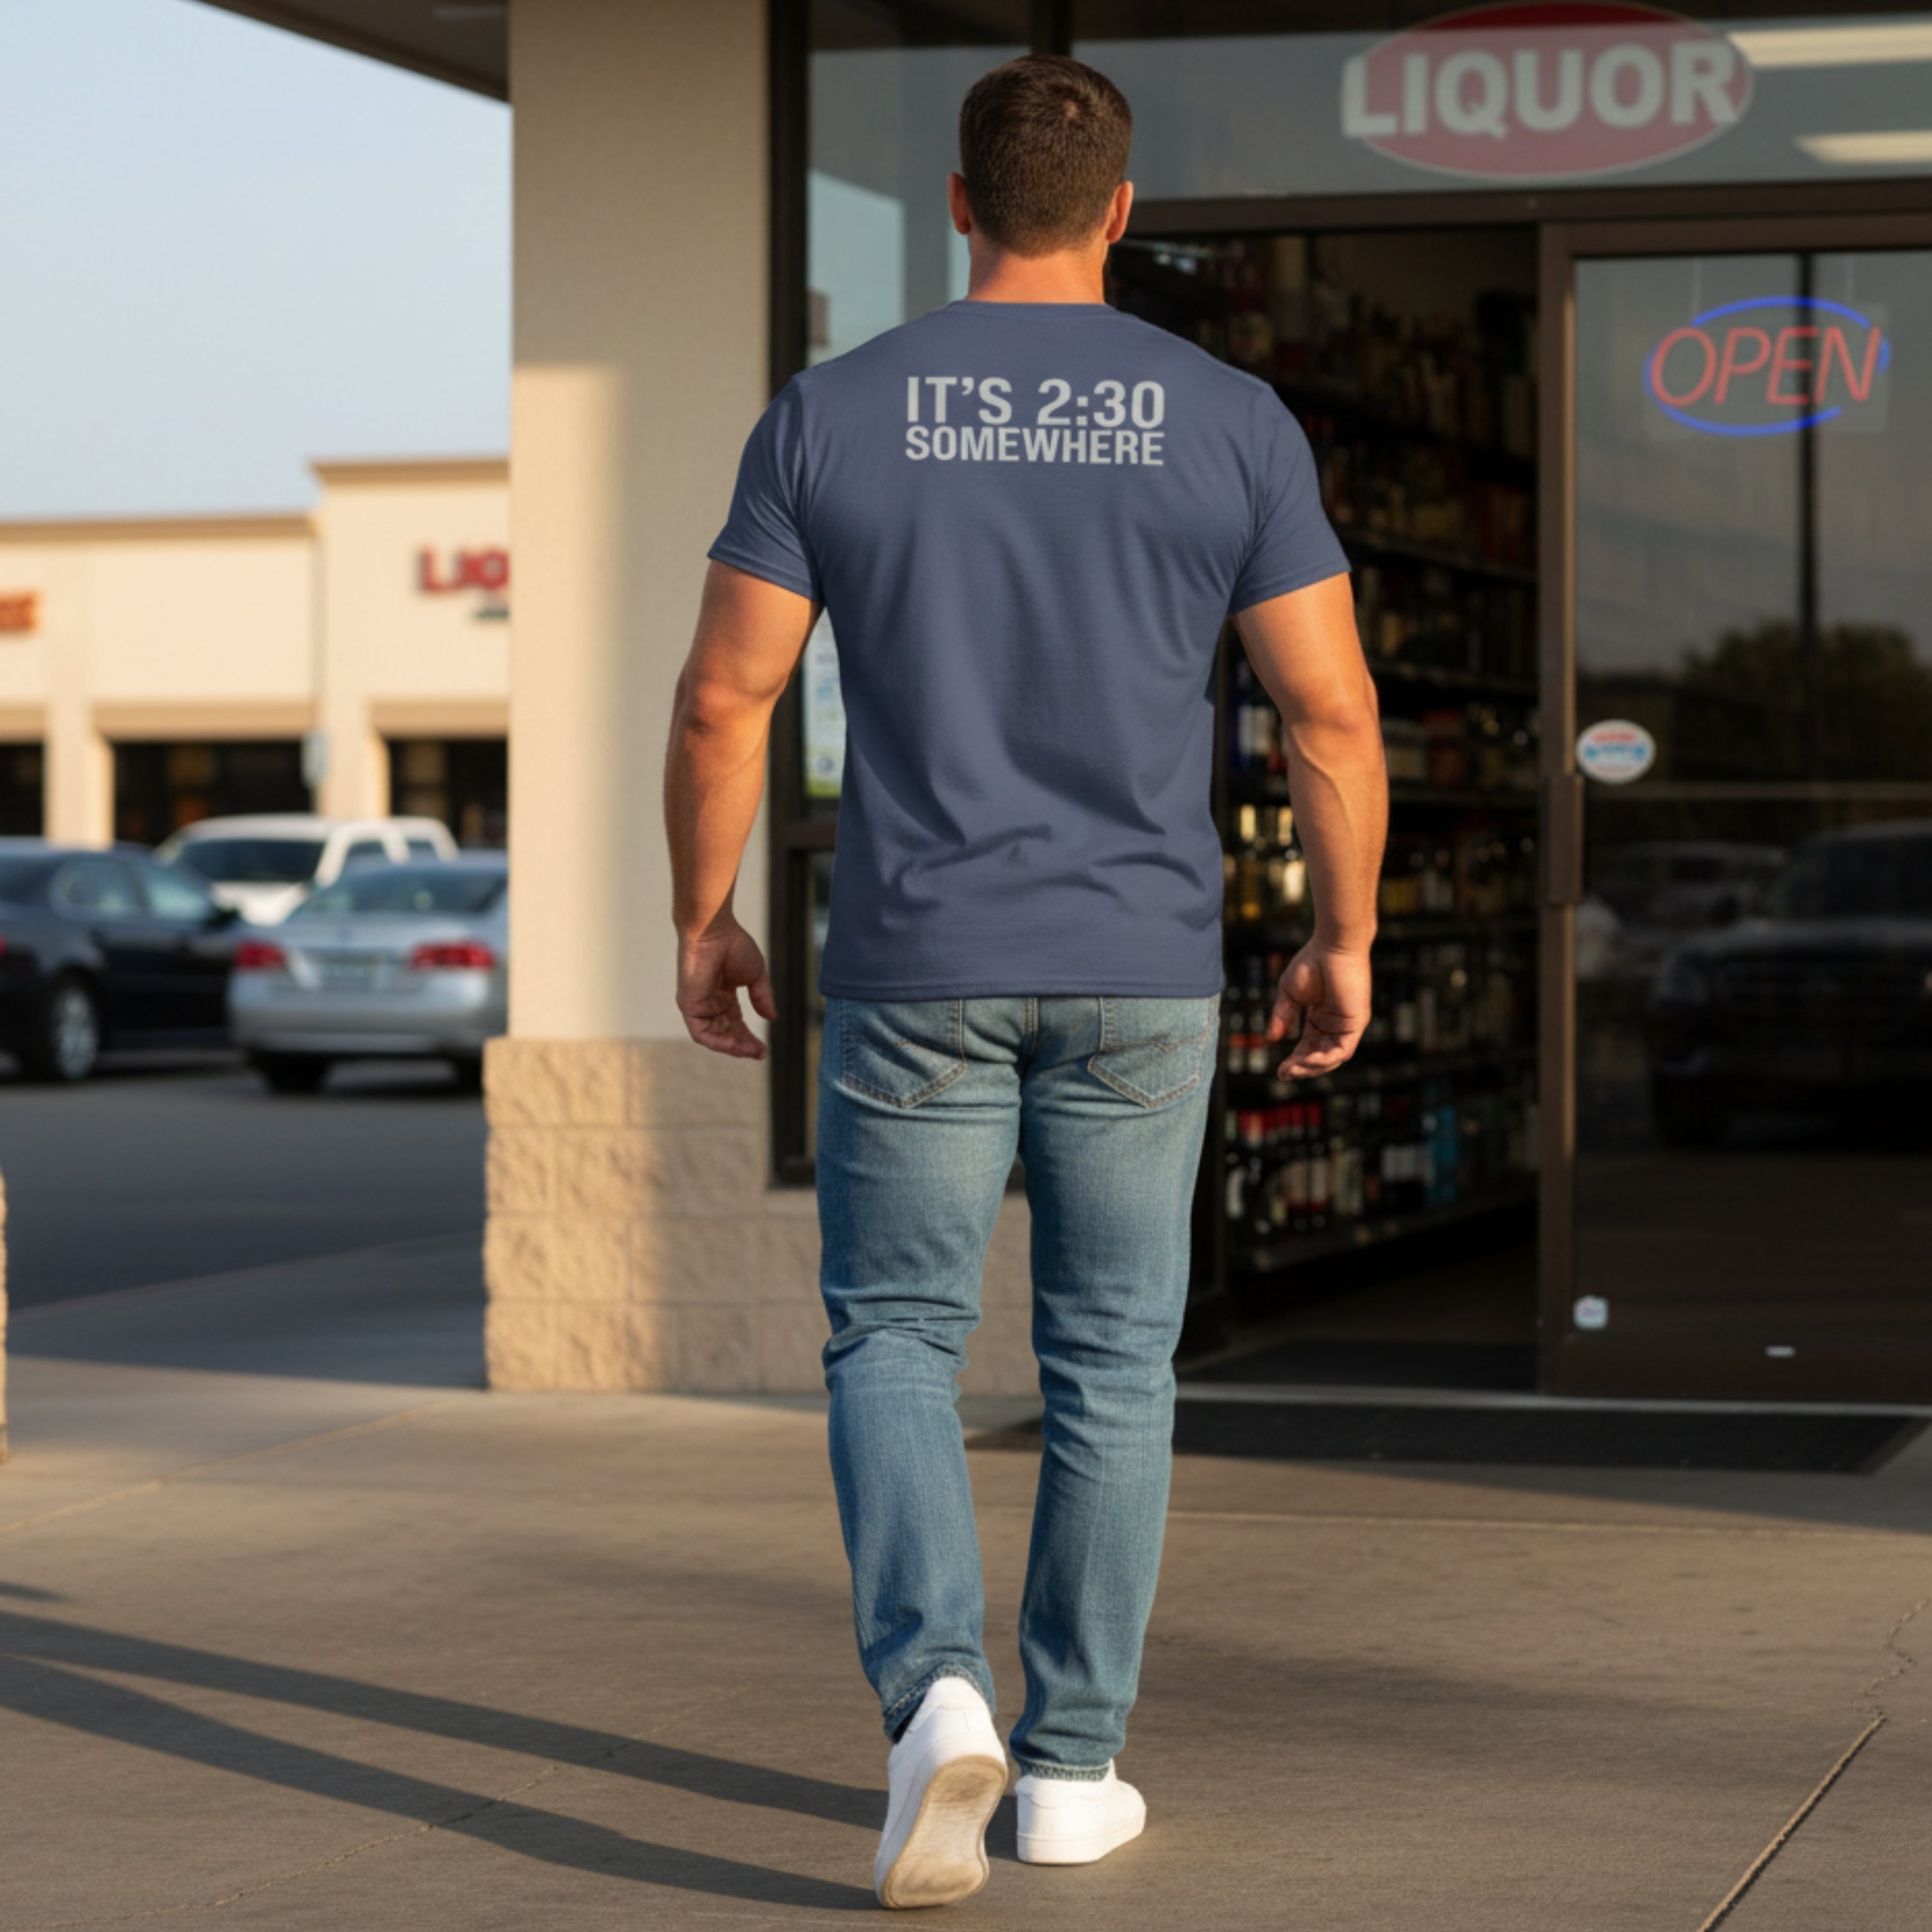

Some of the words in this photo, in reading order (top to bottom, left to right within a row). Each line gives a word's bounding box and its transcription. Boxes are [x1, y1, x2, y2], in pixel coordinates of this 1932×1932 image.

[1341, 41, 1739, 140] LIQUOR
[1651, 326, 1882, 407] OPEN
[907, 377, 1013, 424] IT’S
[1037, 379, 1165, 429] 2:30
[905, 426, 1165, 465] SOMEWHERE
